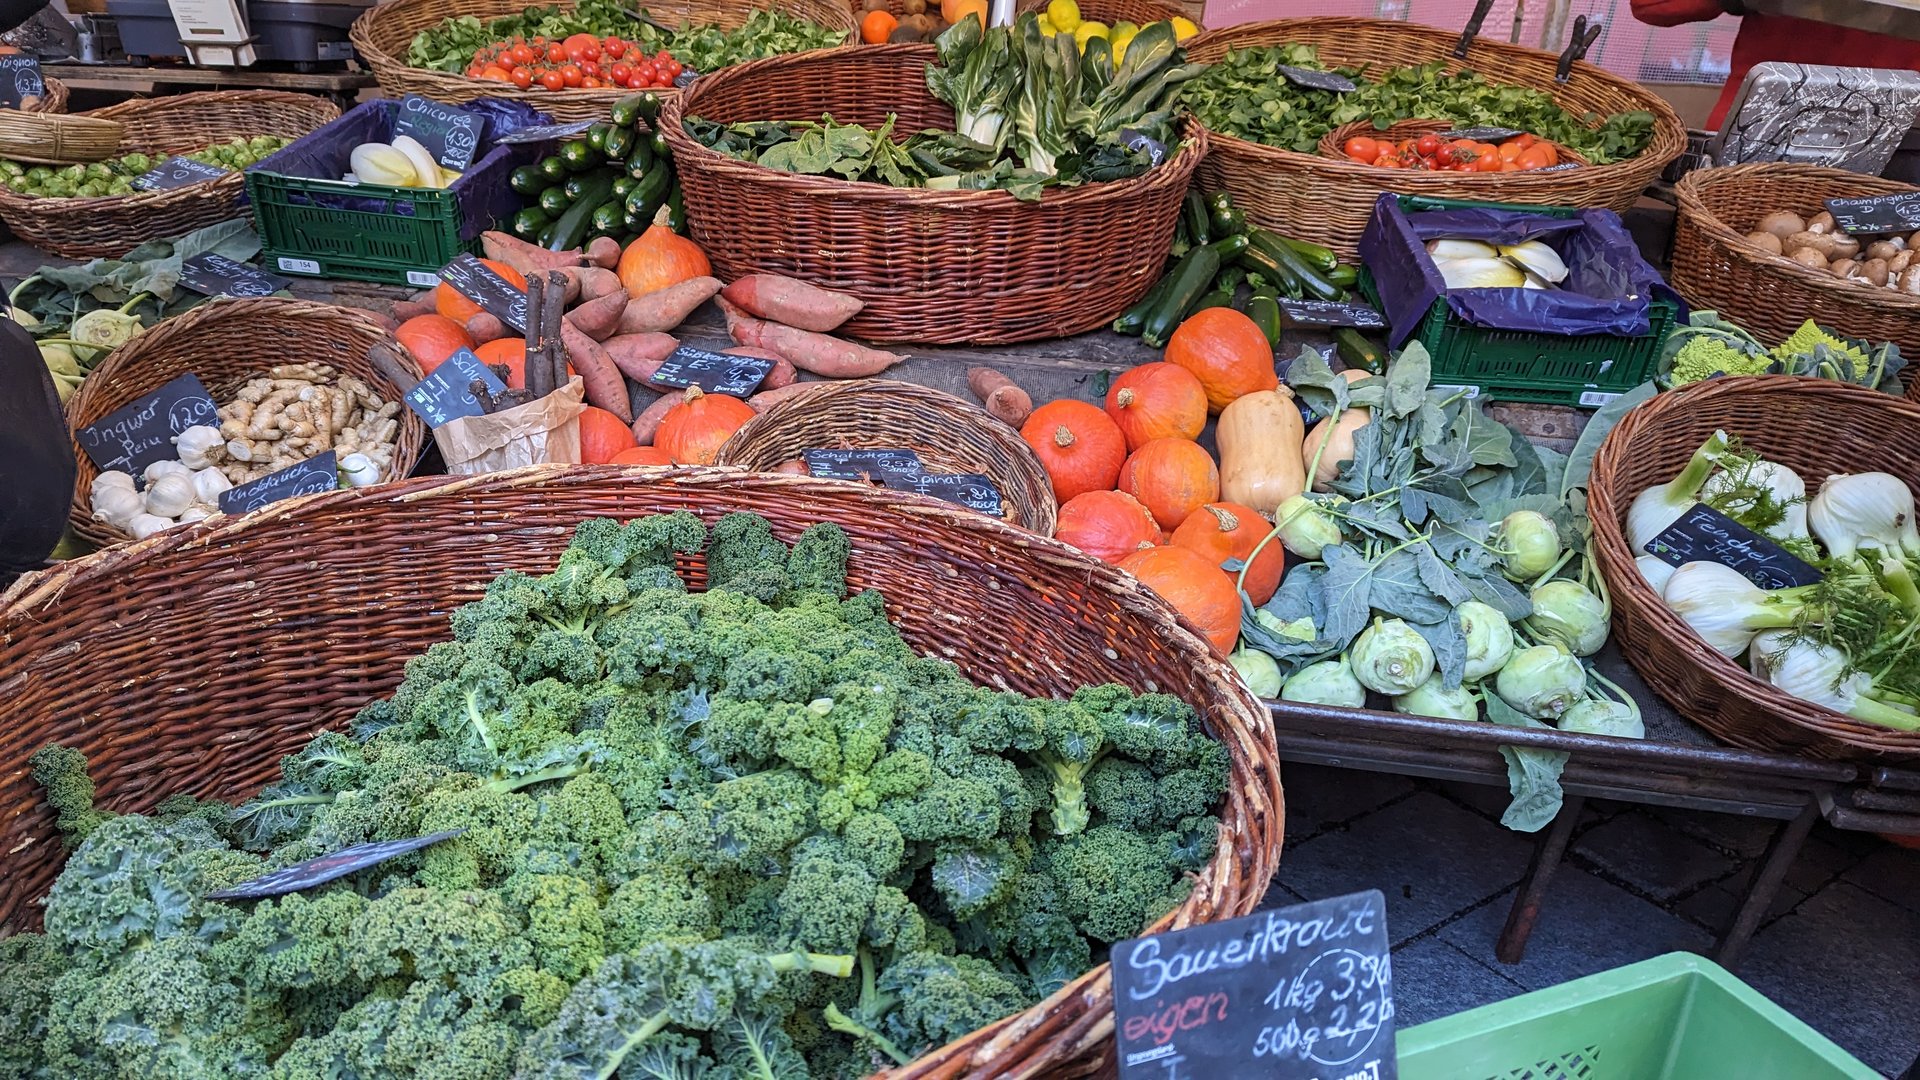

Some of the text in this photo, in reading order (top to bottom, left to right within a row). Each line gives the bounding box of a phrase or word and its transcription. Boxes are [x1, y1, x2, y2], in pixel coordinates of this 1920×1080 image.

[0, 56, 38, 72] pignon
[406, 97, 472, 127] Chicorée
[1859, 205, 1874, 214] D
[903, 474, 964, 485] Spinat
[1689, 511, 1777, 563] Fenchel
[1129, 900, 1376, 1001] Sauerkraut
[1122, 991, 1229, 1046] eigen
